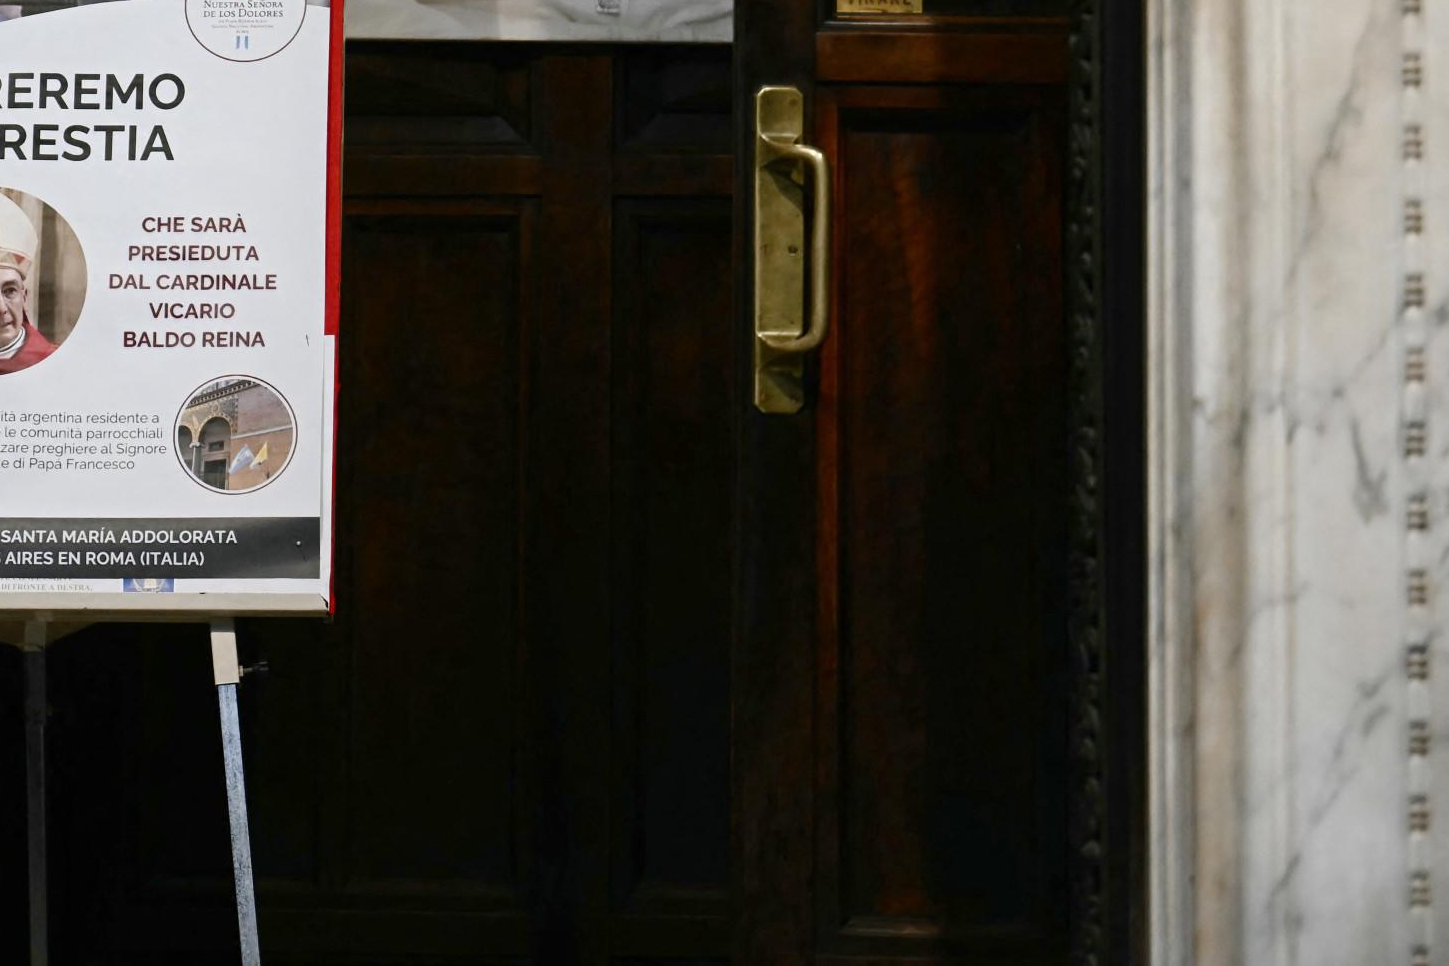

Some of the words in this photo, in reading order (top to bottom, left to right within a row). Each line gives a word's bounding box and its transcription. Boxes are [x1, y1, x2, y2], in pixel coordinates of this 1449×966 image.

[142, 217, 185, 233] CHE
[190, 213, 247, 233] SARÀ
[128, 245, 260, 261] PRESIEDUTA
[108, 274, 151, 290] DAL
[156, 274, 278, 290] CARDINALE
[149, 302, 236, 319] VICARIO
[123, 331, 196, 347] BALDO
[202, 332, 266, 347] REINA
[19, 411, 82, 425] argentina
[86, 412, 149, 424] residente
[152, 414, 160, 424] a
[4, 426, 17, 438] le
[86, 426, 163, 441] parrocchiali
[32, 442, 97, 457] preghiere
[100, 442, 113, 454] al
[116, 443, 167, 457] Signore
[12, 457, 25, 469] di
[66, 458, 135, 470] Francesco
[0, 529, 58, 544] SANTA
[62, 527, 116, 544] MARÍA
[119, 530, 238, 544] ADDOLORATA
[5, 551, 54, 565] AIRES
[58, 551, 81, 565] EN
[85, 551, 136, 565] ROMA
[140, 551, 205, 566] (ITALIA)
